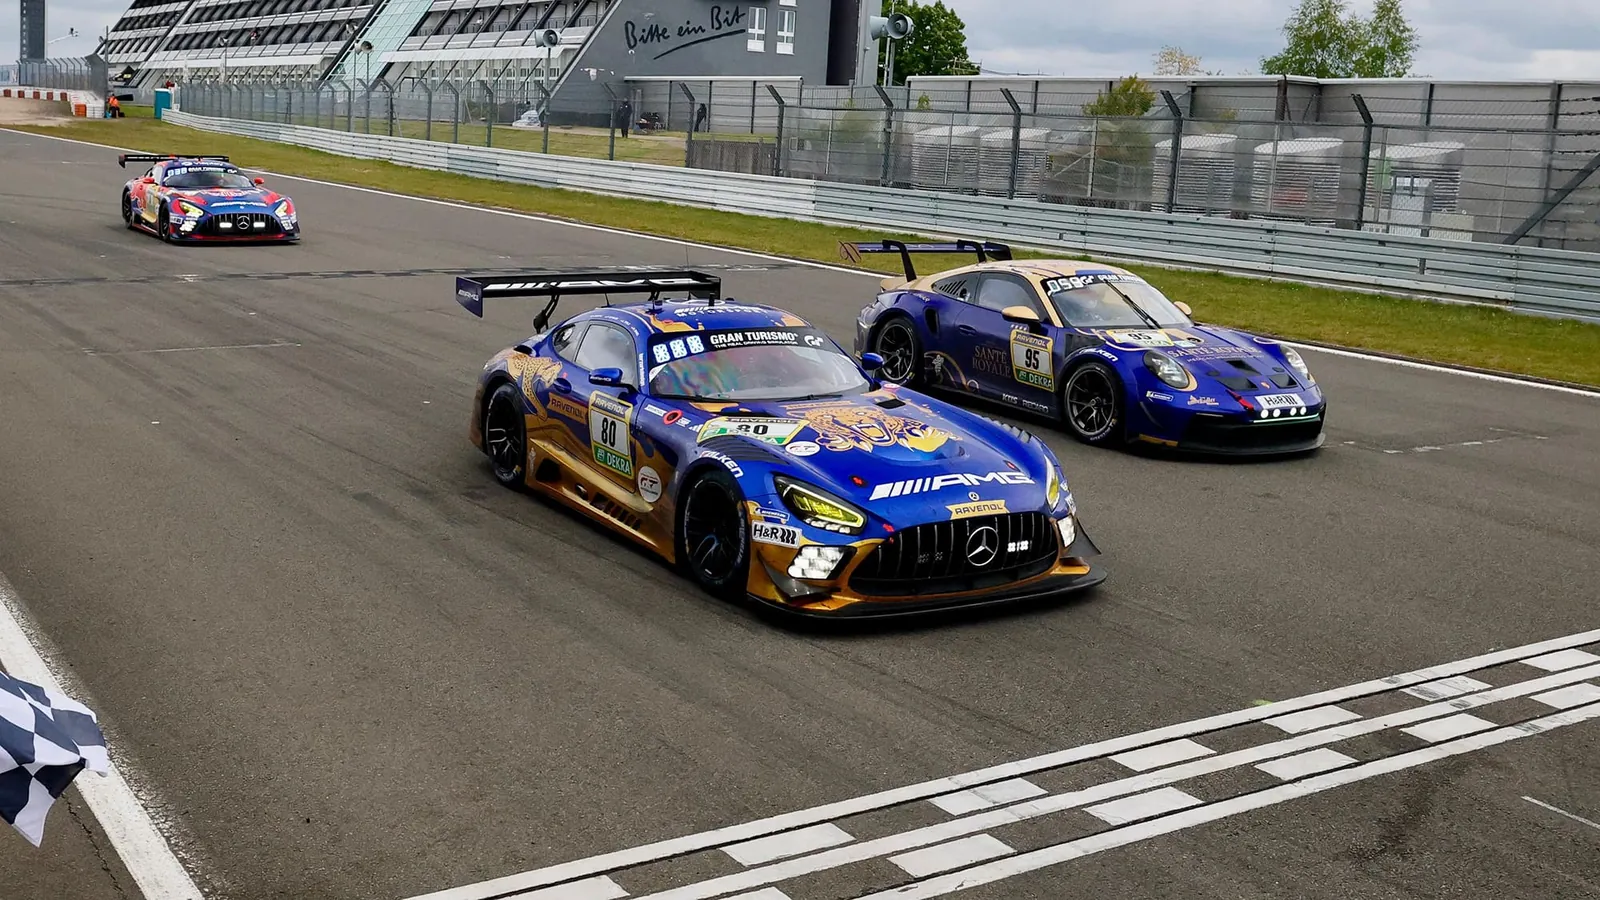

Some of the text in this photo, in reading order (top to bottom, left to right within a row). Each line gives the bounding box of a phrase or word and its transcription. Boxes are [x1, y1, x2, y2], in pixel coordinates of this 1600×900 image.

[624, 5, 746, 49] Bitte ein Bit
[710, 331, 795, 345] GRAN TURISMO
[1016, 333, 1046, 347] RAVENOL
[972, 357, 1012, 378] ROYALE
[1024, 348, 1040, 370] 95
[1028, 373, 1052, 388] DEKRA
[551, 398, 584, 419] RAVENOL
[595, 397, 625, 415] RAVENOL
[601, 417, 616, 447] 80
[606, 453, 631, 475] DEKRA
[955, 503, 1004, 515] RAVENOL
[754, 524, 779, 540] H&R
